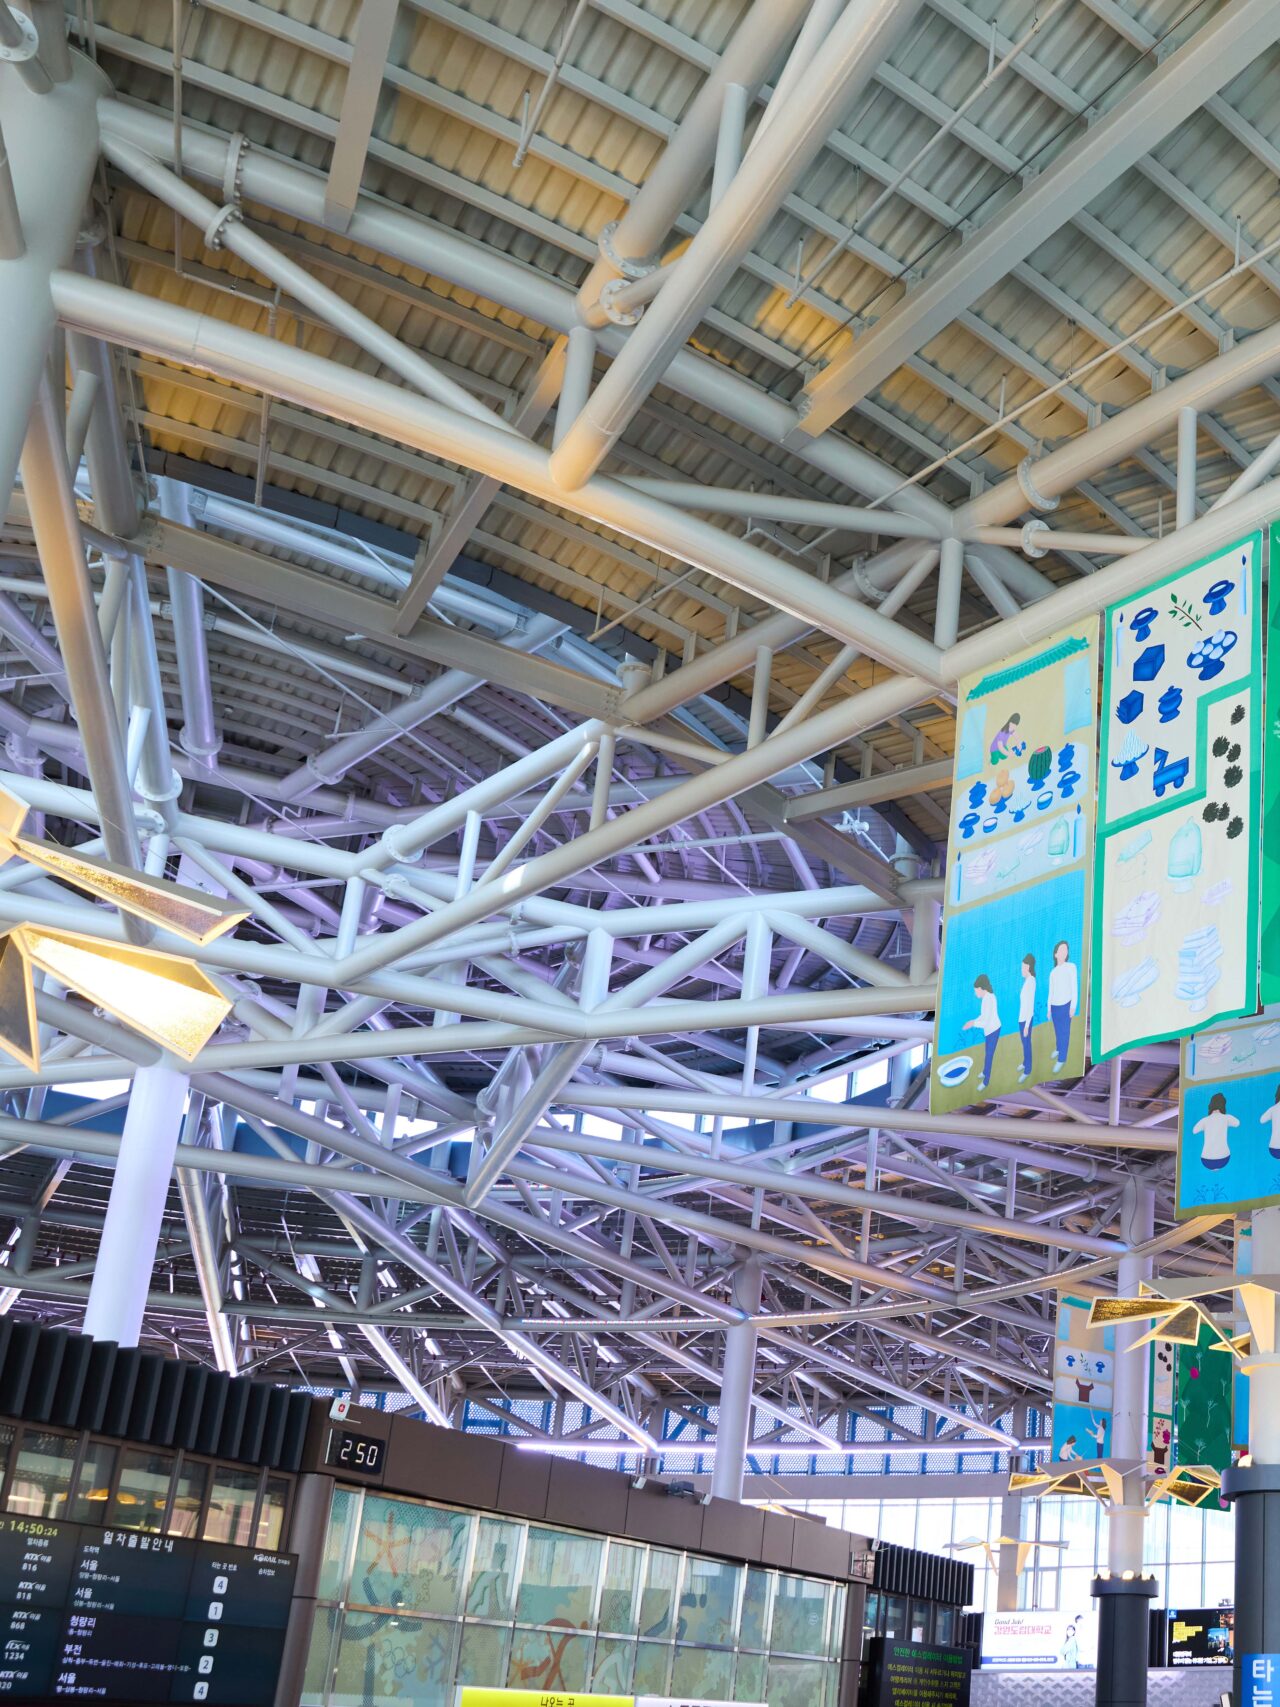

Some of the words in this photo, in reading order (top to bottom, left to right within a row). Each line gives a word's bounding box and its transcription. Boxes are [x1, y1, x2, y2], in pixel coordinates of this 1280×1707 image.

[10, 1520, 58, 1537] 14:50:24
[24, 1552, 40, 1561] KTX
[80, 1560, 98, 1571] 서울
[18, 1581, 34, 1590] KTX
[75, 1587, 93, 1599] 서울
[12, 1611, 29, 1620] KTX
[70, 1615, 96, 1628] 청량리
[4, 1651, 24, 1660] 1234
[64, 1644, 82, 1656] 부전
[58, 1672, 76, 1684] 서울
